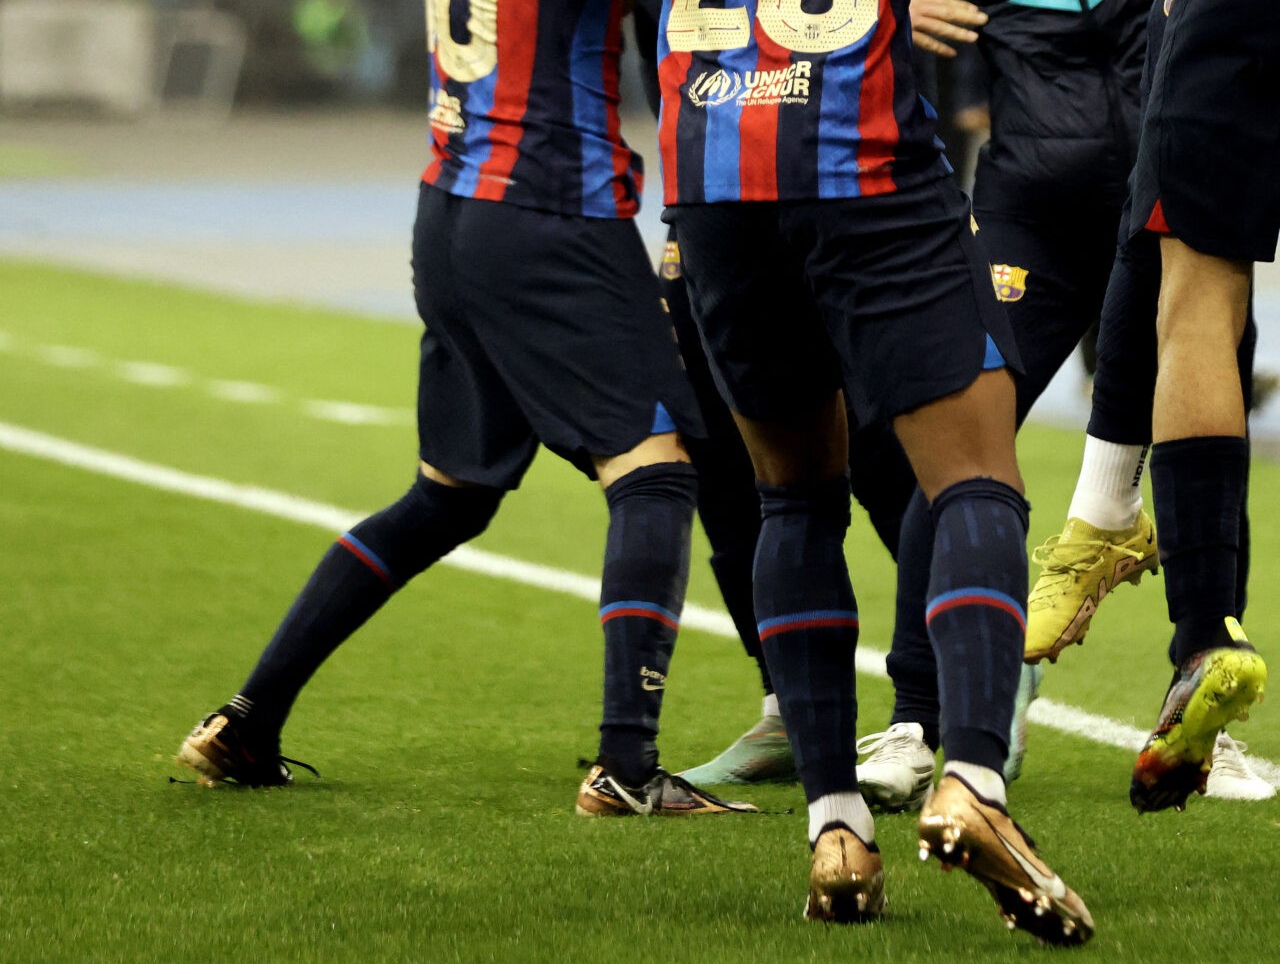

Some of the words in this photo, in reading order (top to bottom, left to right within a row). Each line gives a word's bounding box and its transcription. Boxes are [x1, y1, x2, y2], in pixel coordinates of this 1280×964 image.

[744, 60, 812, 88] UNHCR
[736, 78, 810, 100] ACNUR
[747, 98, 757, 106] UN
[757, 97, 782, 106] Refugee
[782, 96, 809, 105] Agency
